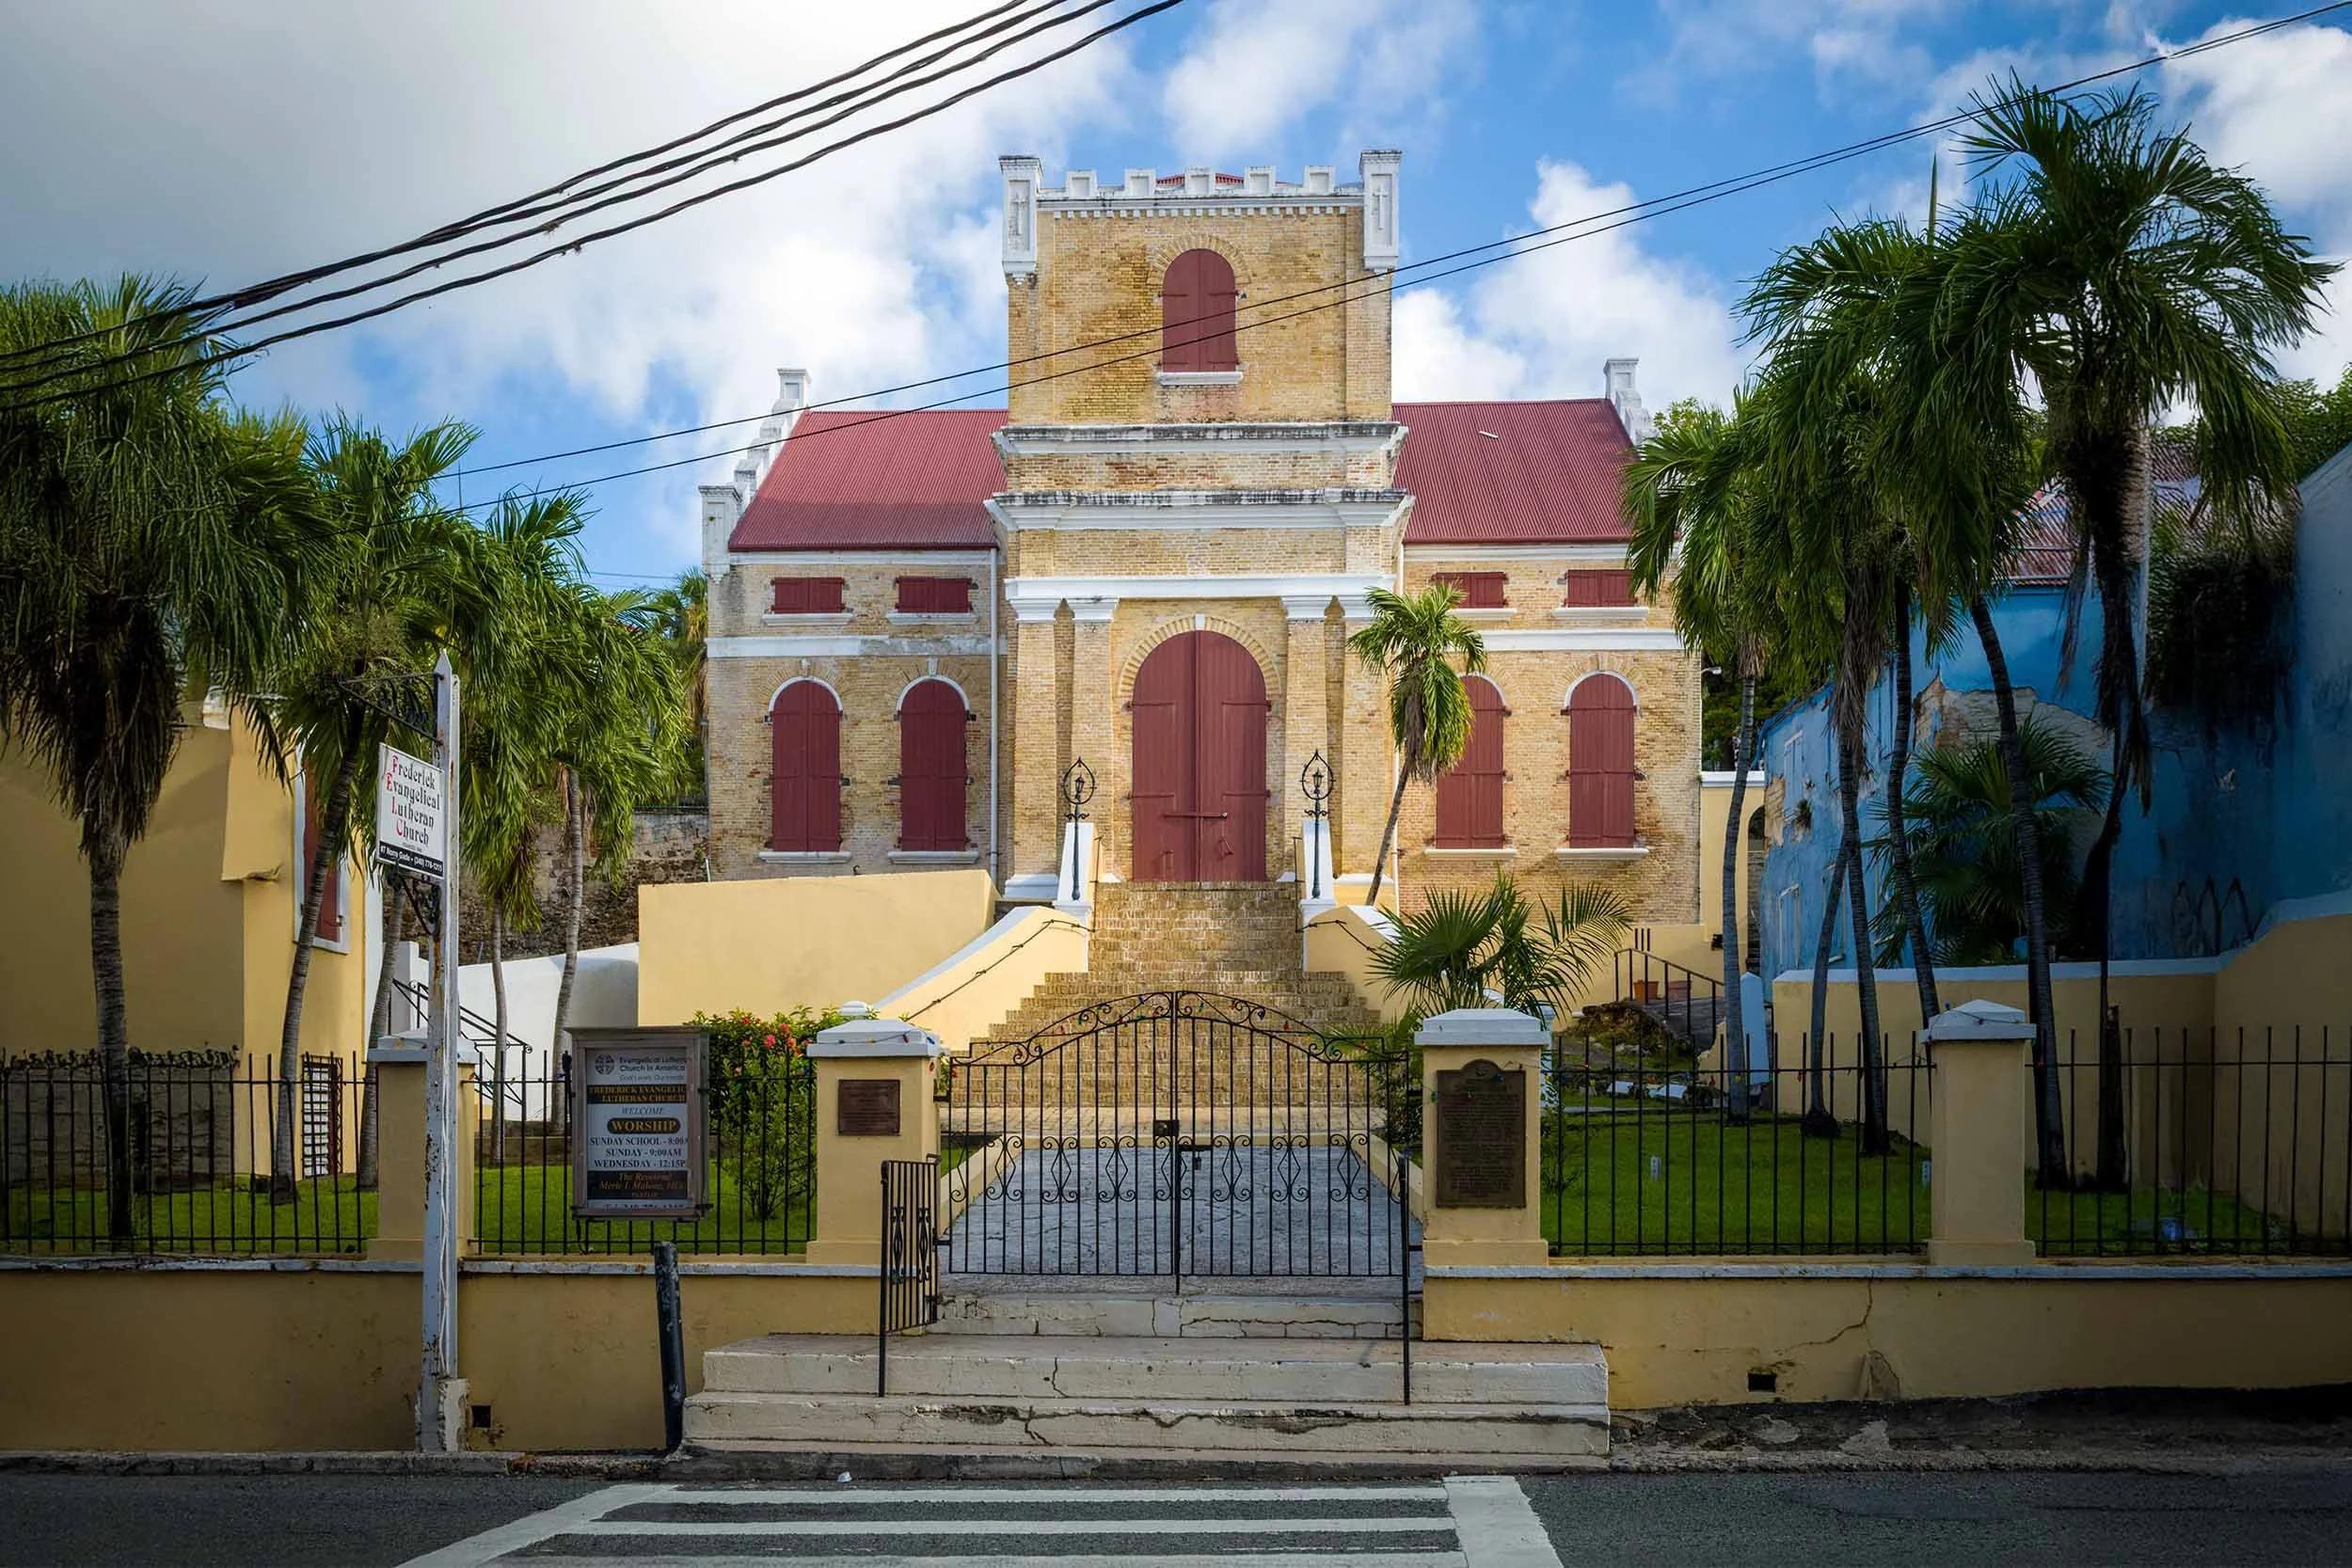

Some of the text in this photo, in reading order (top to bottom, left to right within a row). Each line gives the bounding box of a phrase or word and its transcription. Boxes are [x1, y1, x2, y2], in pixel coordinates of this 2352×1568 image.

[392, 755, 436, 789] Frederick
[386, 772, 440, 810] Evangelical
[391, 797, 435, 830] Lutheran
[396, 818, 429, 847] Church
[612, 1121, 677, 1131] WORSHIP
